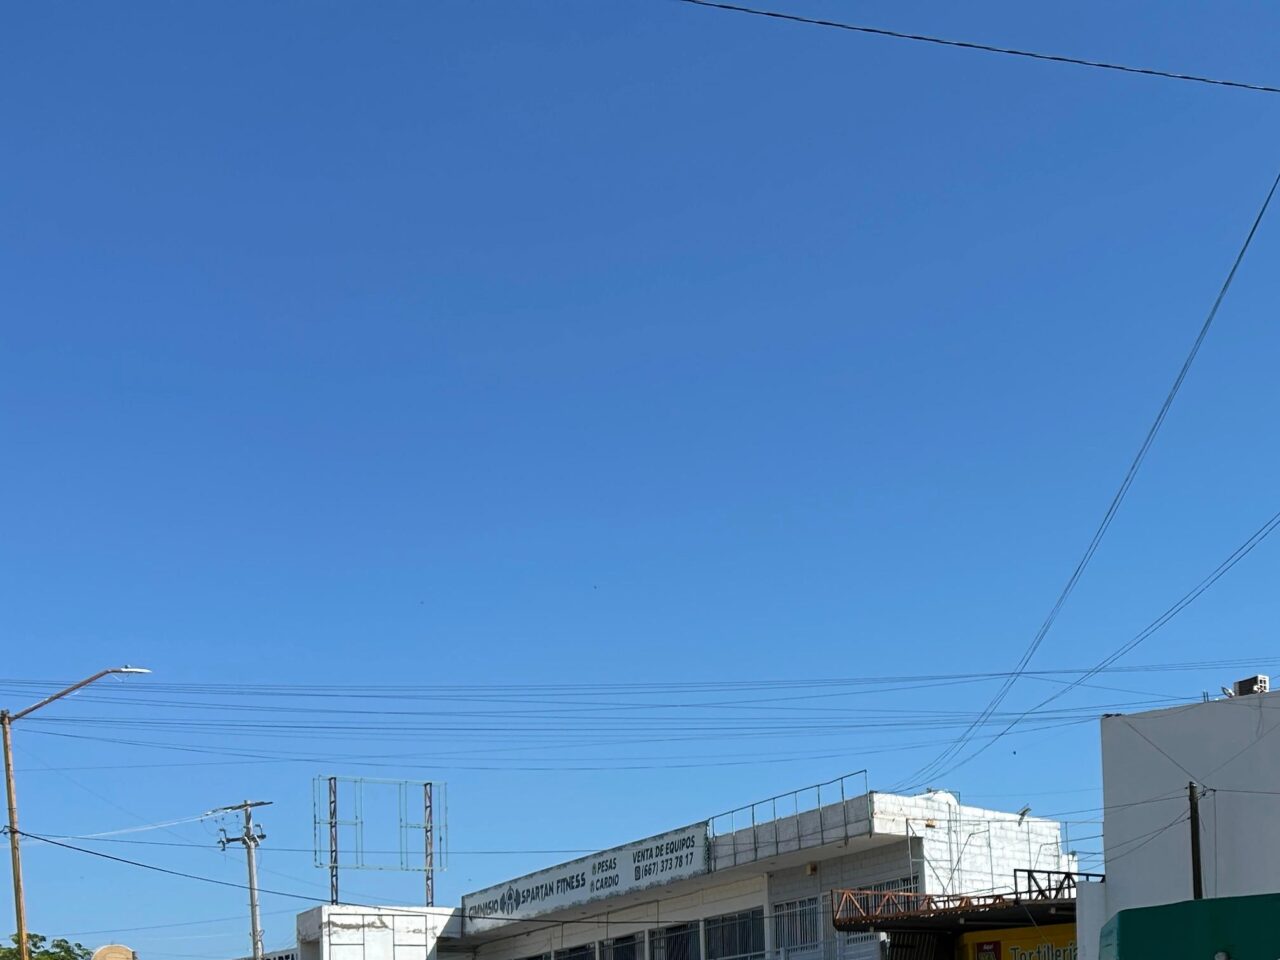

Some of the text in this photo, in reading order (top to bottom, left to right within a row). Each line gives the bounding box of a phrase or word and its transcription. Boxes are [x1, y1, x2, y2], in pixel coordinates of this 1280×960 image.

[632, 835, 695, 864] VENTA DE EQUIPOS
[597, 857, 617, 874] PESAS
[641, 860, 659, 879] (667)
[660, 857, 673, 872] 373
[685, 852, 694, 866] 17
[521, 881, 554, 904] SPARTAN
[556, 872, 586, 895] FITNESS
[595, 874, 619, 891] CARDIO
